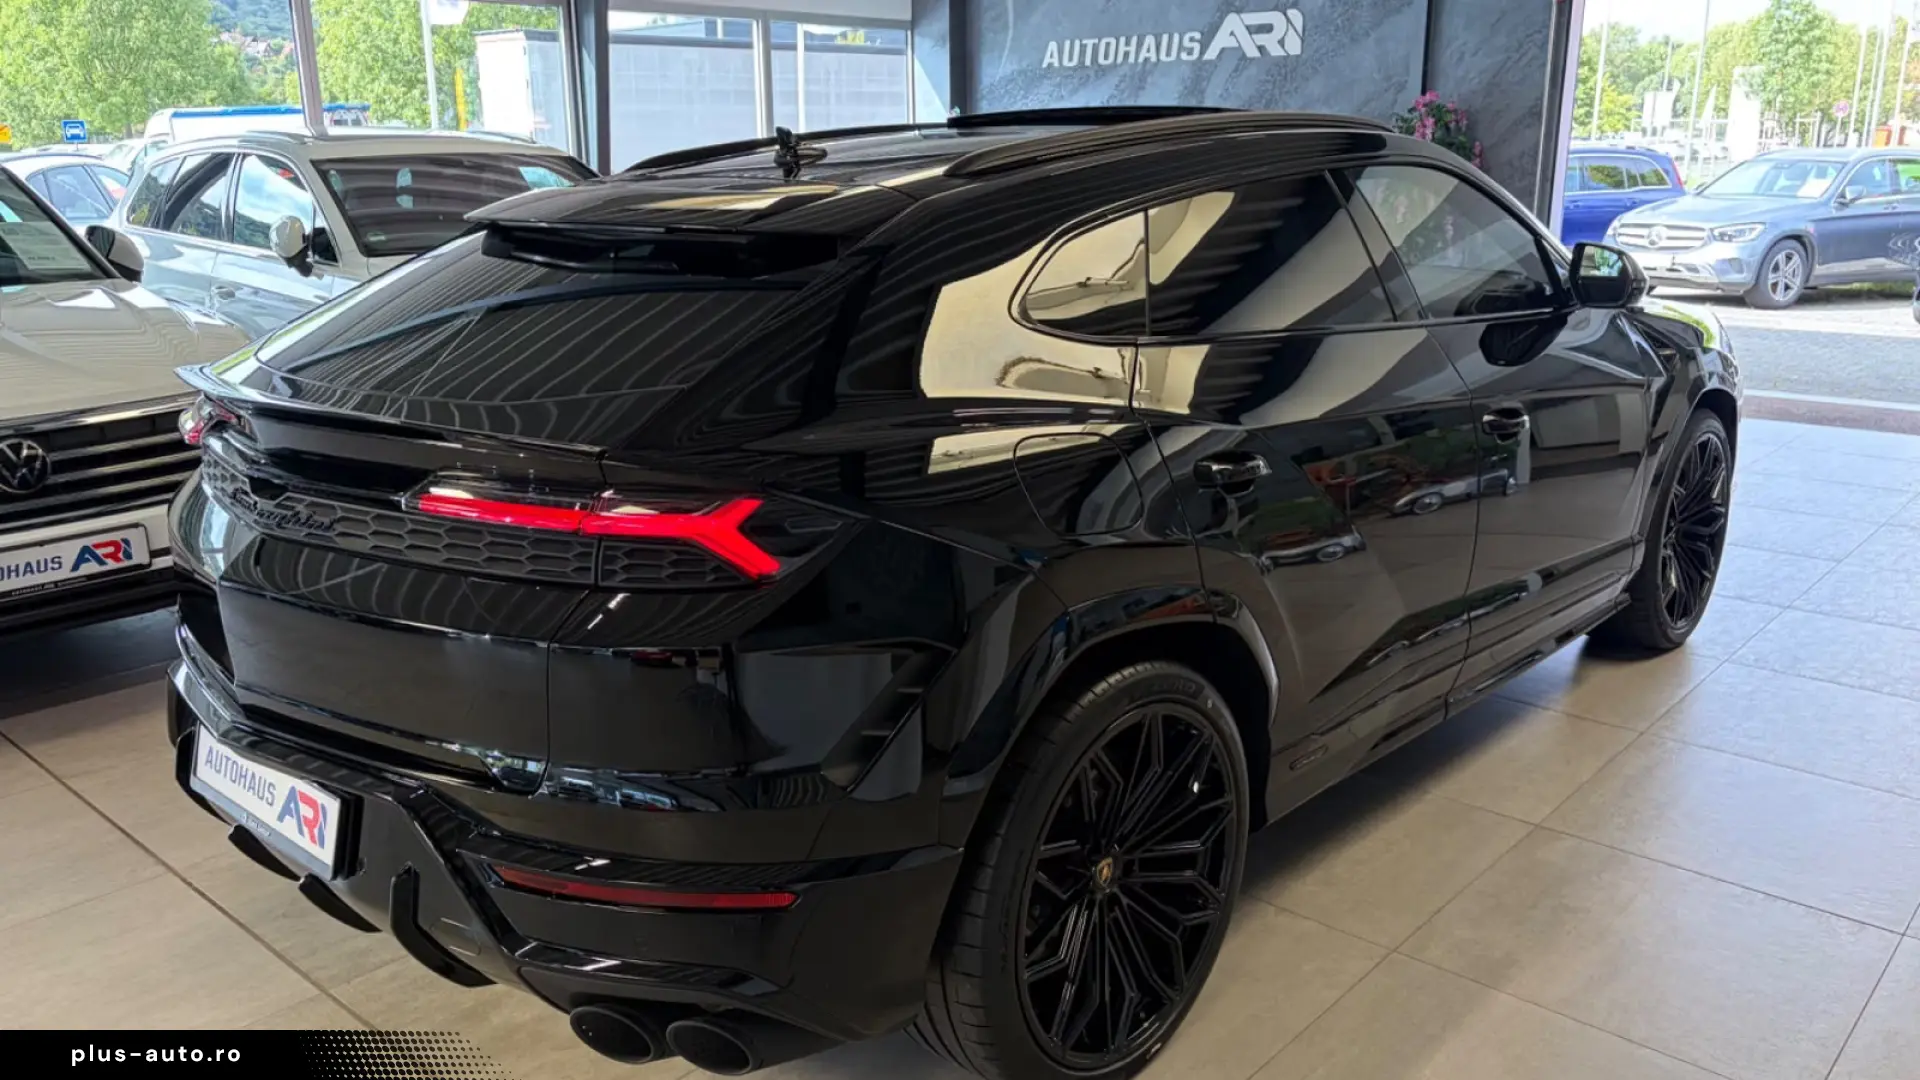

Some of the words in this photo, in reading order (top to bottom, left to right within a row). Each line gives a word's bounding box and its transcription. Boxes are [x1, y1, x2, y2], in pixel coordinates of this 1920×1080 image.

[1042, 31, 1201, 68] AUTOHAUS
[1202, 8, 1304, 61] ARI
[70, 537, 133, 573] ARI
[205, 746, 277, 807] AUTOHAUS
[277, 785, 328, 849] ARI
